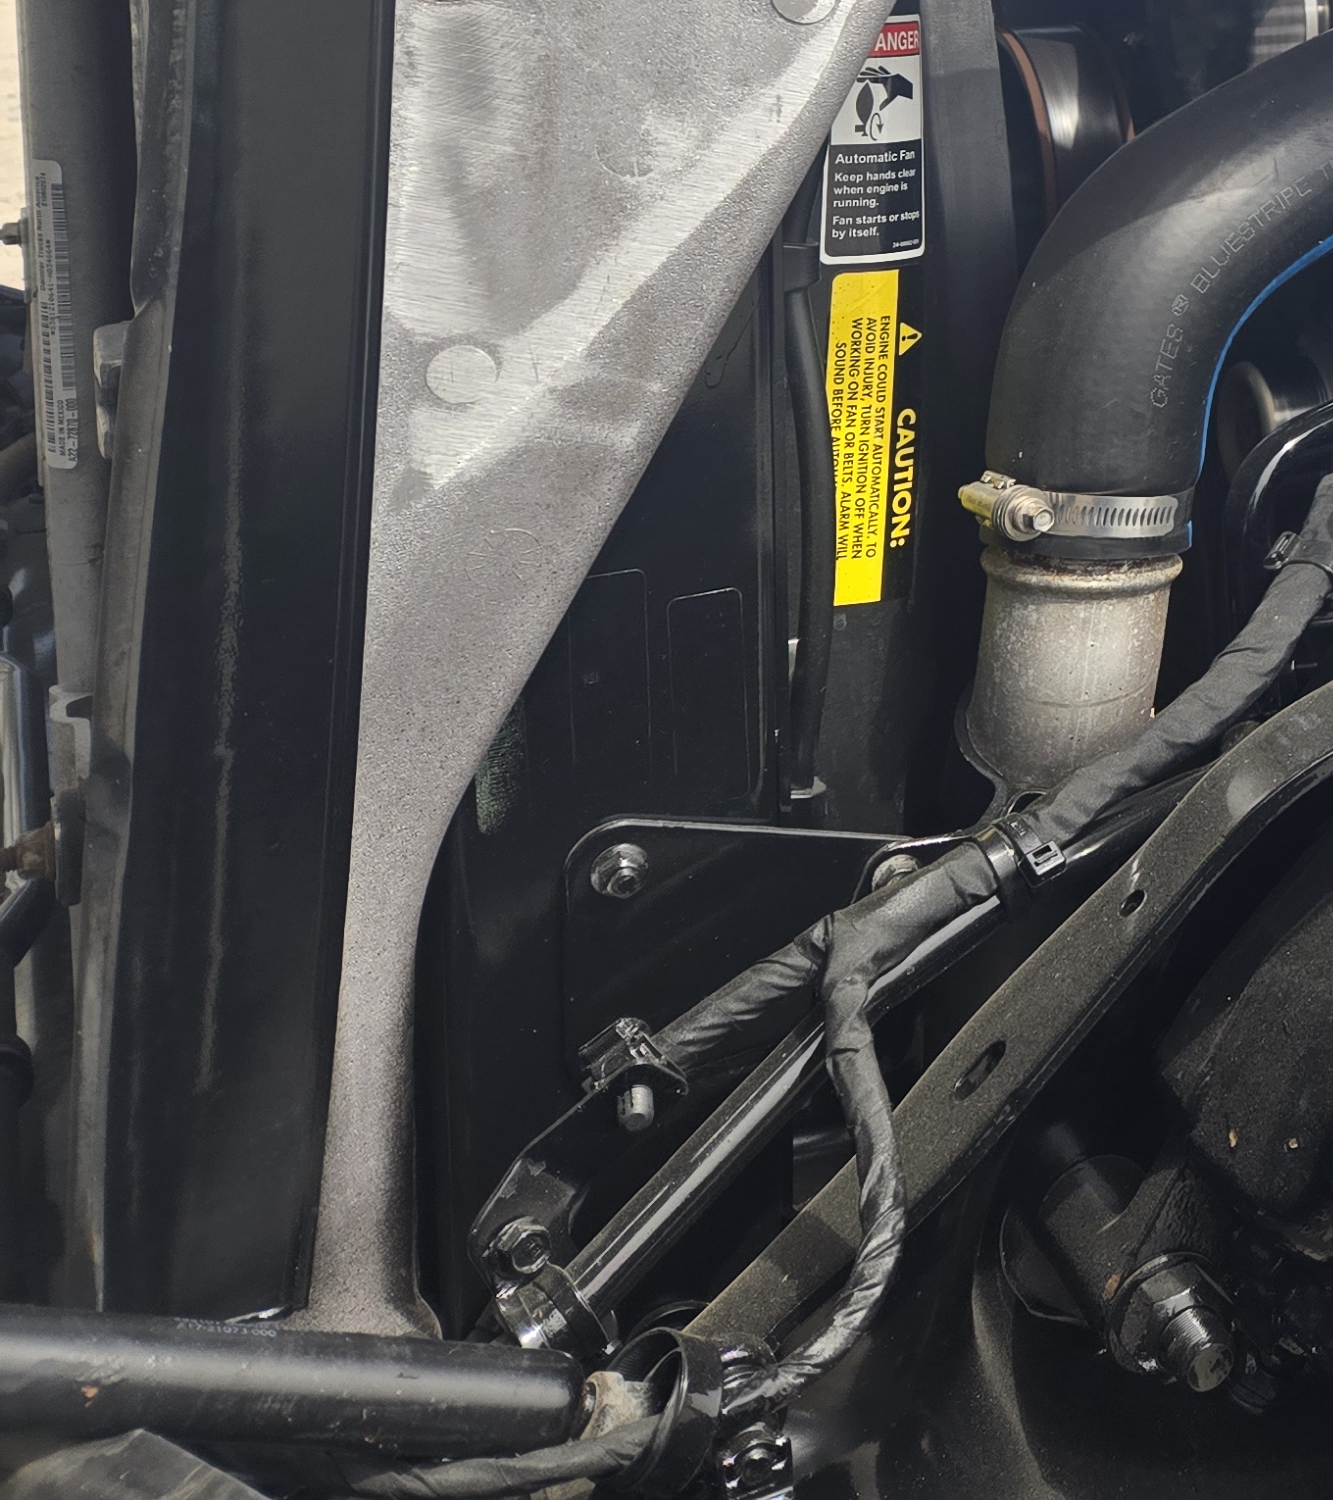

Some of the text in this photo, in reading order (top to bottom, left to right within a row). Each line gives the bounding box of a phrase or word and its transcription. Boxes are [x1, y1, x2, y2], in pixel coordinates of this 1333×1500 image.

[874, 30, 919, 52] ANGER
[834, 168, 916, 183] Keep hands clear
[835, 149, 916, 165] Automatic Fan
[833, 181, 908, 195] when engine is
[833, 197, 879, 208] running.
[832, 210, 920, 226] Fan starts or stops
[832, 226, 879, 240] by itself.
[1150, 322, 1184, 409] GATES
[1190, 176, 1312, 295] BLUESTRIPE
[833, 342, 847, 385] SOUND
[57, 399, 67, 456] MADE IN MEXICO
[831, 389, 844, 431] BEFORE
[836, 317, 863, 561] WORKING ON FAN OR BELTS. ALARM WILL
[851, 317, 877, 559] AVOID INJURY, TURN IGNITION OFF WHEN
[865, 315, 890, 558] ENGINE COULD START AUTOMATICALLY. TO
[889, 408, 917, 548] CAUTION:
